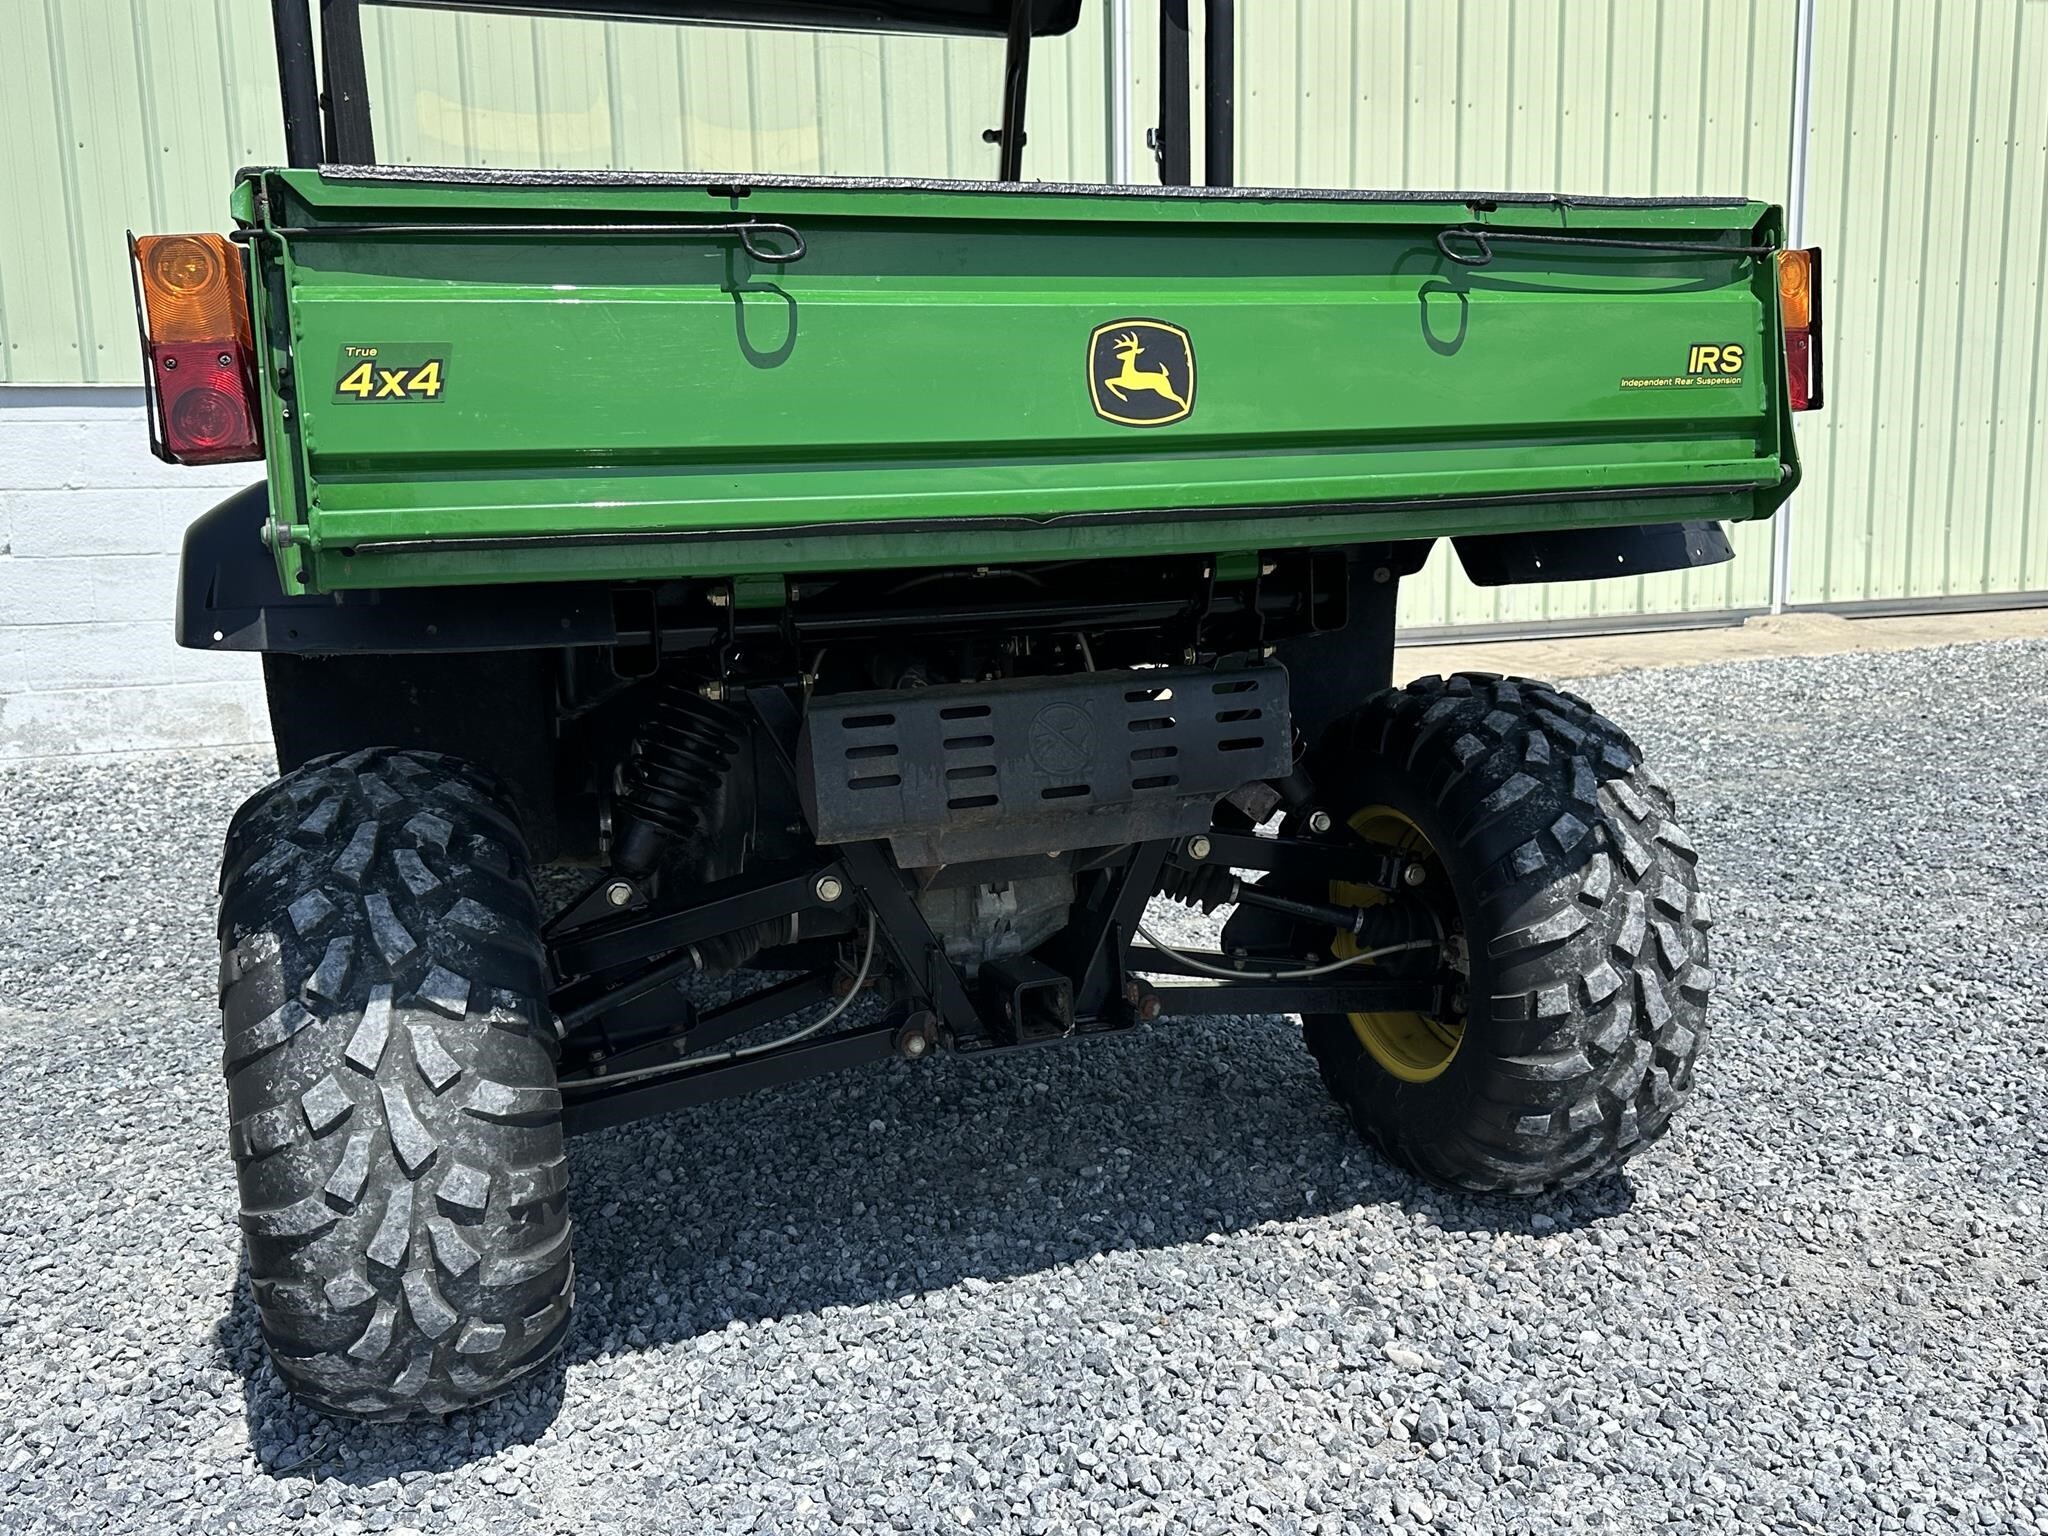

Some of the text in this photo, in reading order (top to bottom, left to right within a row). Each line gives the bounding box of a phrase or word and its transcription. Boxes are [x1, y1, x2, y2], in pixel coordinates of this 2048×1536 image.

[345, 346, 378, 357] True
[1687, 344, 1744, 374] IRS
[338, 361, 442, 398] 4x4
[1621, 376, 1742, 388] Independent Rear Suspension
